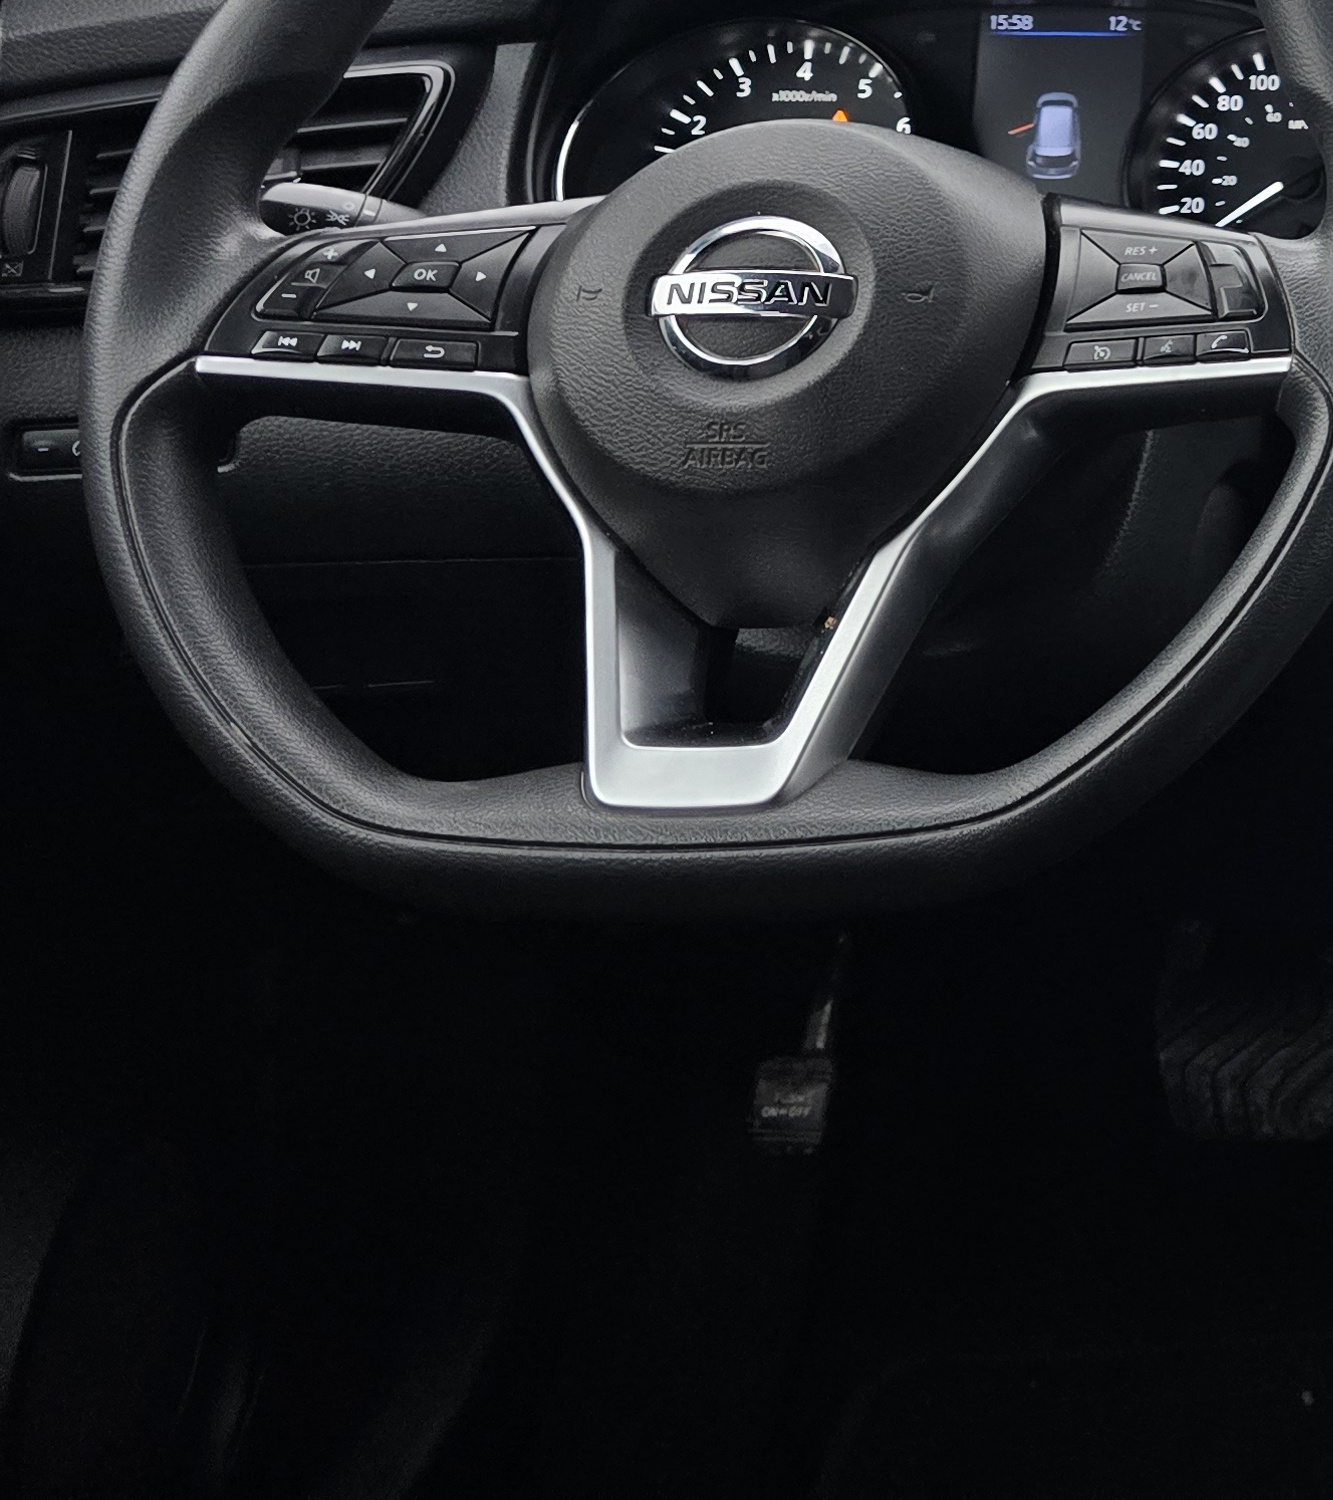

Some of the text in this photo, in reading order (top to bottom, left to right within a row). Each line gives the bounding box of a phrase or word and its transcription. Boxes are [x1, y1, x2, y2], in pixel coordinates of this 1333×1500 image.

[989, 15, 1033, 31] 15:58
[796, 62, 813, 81] 4
[736, 77, 752, 98] 3
[857, 78, 872, 99] 5
[1249, 74, 1280, 91] 100
[1217, 95, 1243, 112] 80
[691, 114, 707, 136] 2
[896, 116, 911, 134] 6
[1191, 123, 1218, 140] 60
[1178, 159, 1205, 176] 40
[1222, 175, 1237, 186] 20
[1179, 198, 1205, 214] 20
[1124, 246, 1146, 256] RES
[413, 269, 438, 281] OK
[1120, 271, 1157, 283] CANCEL
[666, 279, 833, 307] NISSAN
[1125, 302, 1146, 313] SET
[704, 421, 747, 442] SRS
[683, 449, 770, 469] AIRBAG
